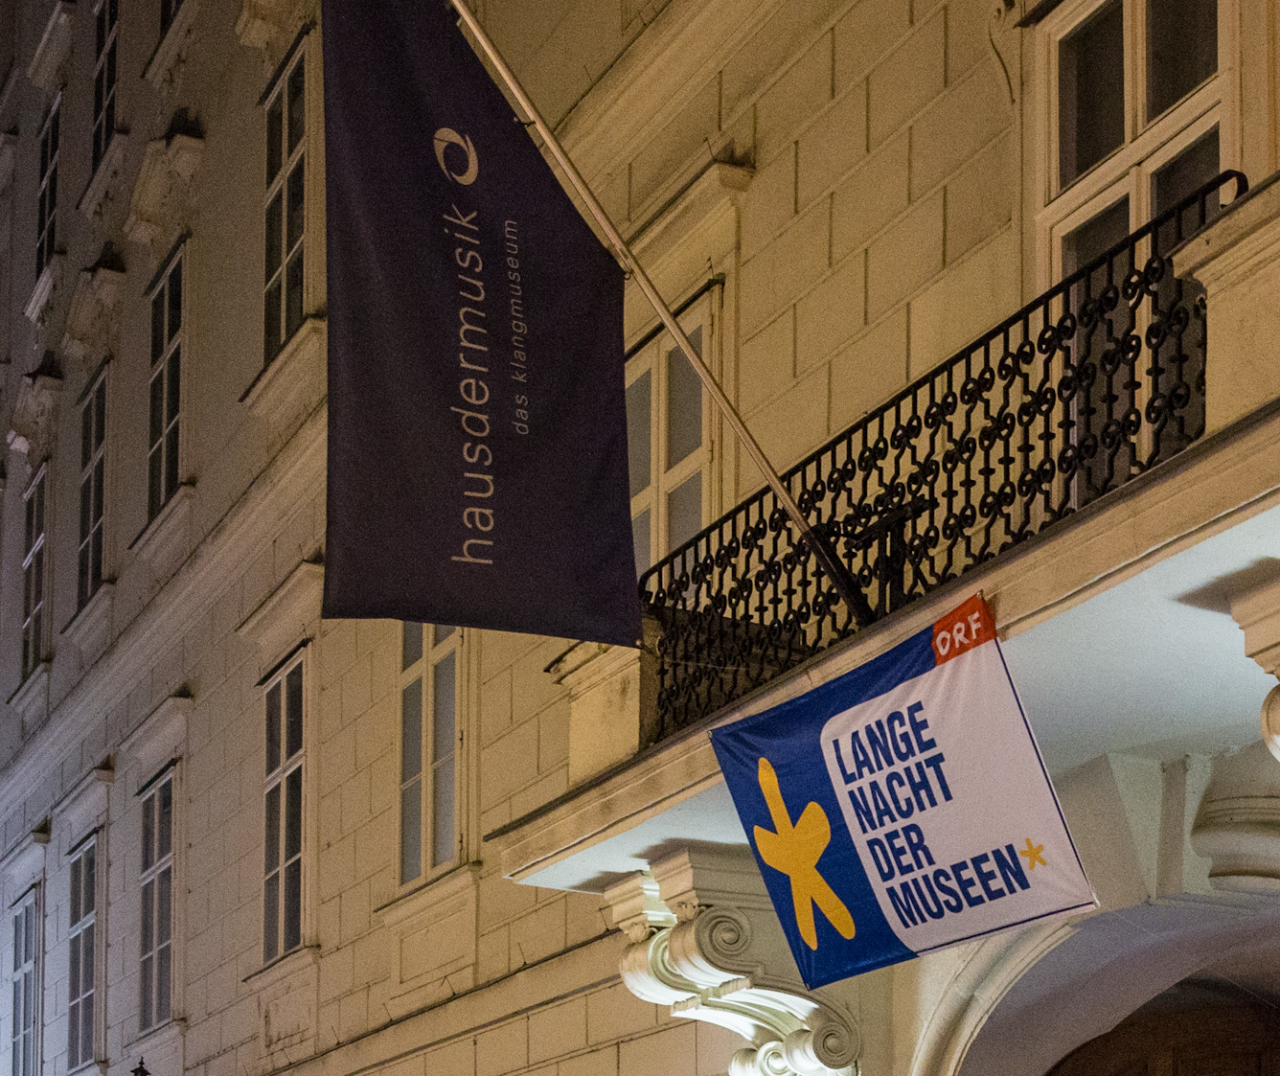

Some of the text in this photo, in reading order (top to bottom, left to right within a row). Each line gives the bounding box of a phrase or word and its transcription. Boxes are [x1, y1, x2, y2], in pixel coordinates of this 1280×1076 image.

[504, 220, 529, 435] das klangmuseum
[443, 204, 494, 565] hausdermusik
[935, 612, 982, 656] ORF
[832, 700, 937, 785] LANGE
[847, 752, 953, 834] NACHT
[866, 822, 936, 882] DER
[886, 843, 1031, 929] MUSEEN
